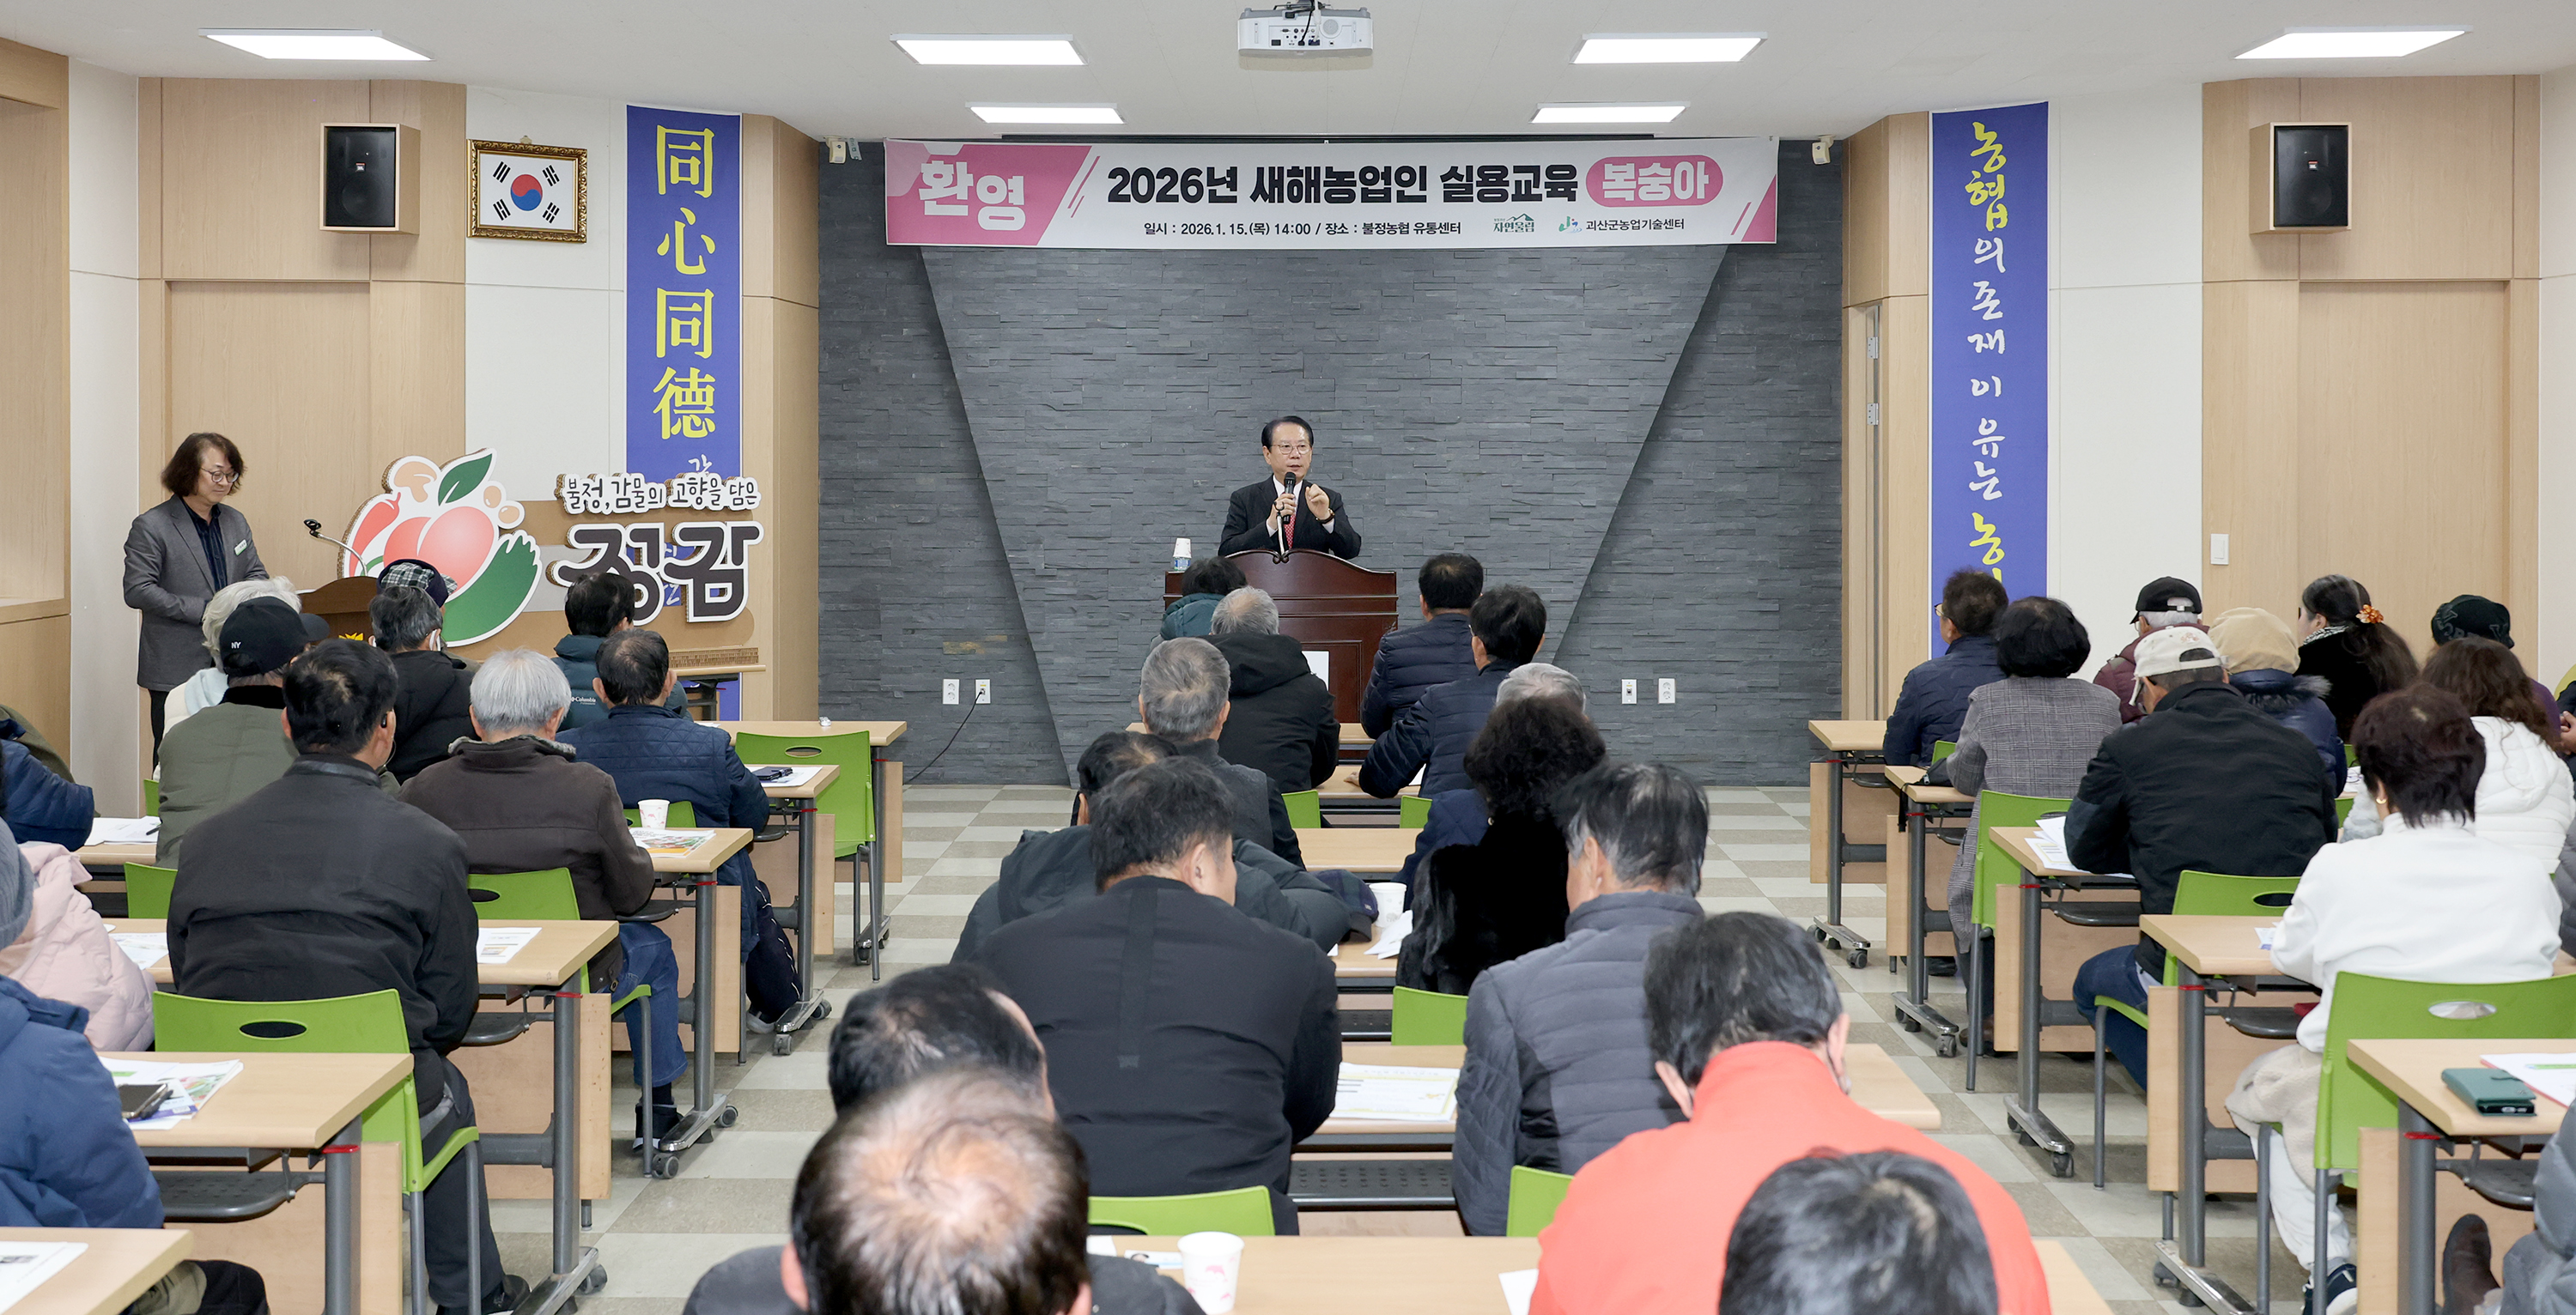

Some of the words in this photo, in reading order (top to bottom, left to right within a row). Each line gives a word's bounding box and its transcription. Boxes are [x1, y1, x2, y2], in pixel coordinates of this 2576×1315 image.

[918, 160, 1026, 231] 환영
[1108, 166, 1238, 204] 2026년
[1249, 165, 1427, 204] 새해농업인
[1440, 164, 1578, 203] 실용교육
[1601, 160, 1710, 201] 복숭아
[1144, 222, 1167, 235] 일시
[1274, 223, 1311, 235] 14:00
[1325, 222, 1350, 236] 장소
[1362, 221, 1410, 235] 불정농협
[1413, 221, 1461, 235] 유통센터
[1493, 221, 1534, 233] 자연울림
[1586, 218, 1685, 232] 괴산군농업기술센터
[566, 477, 663, 511] 불정,감물의
[672, 477, 722, 506] 고향을
[729, 481, 758, 506] 담은
[1969, 512, 2006, 583] 농
